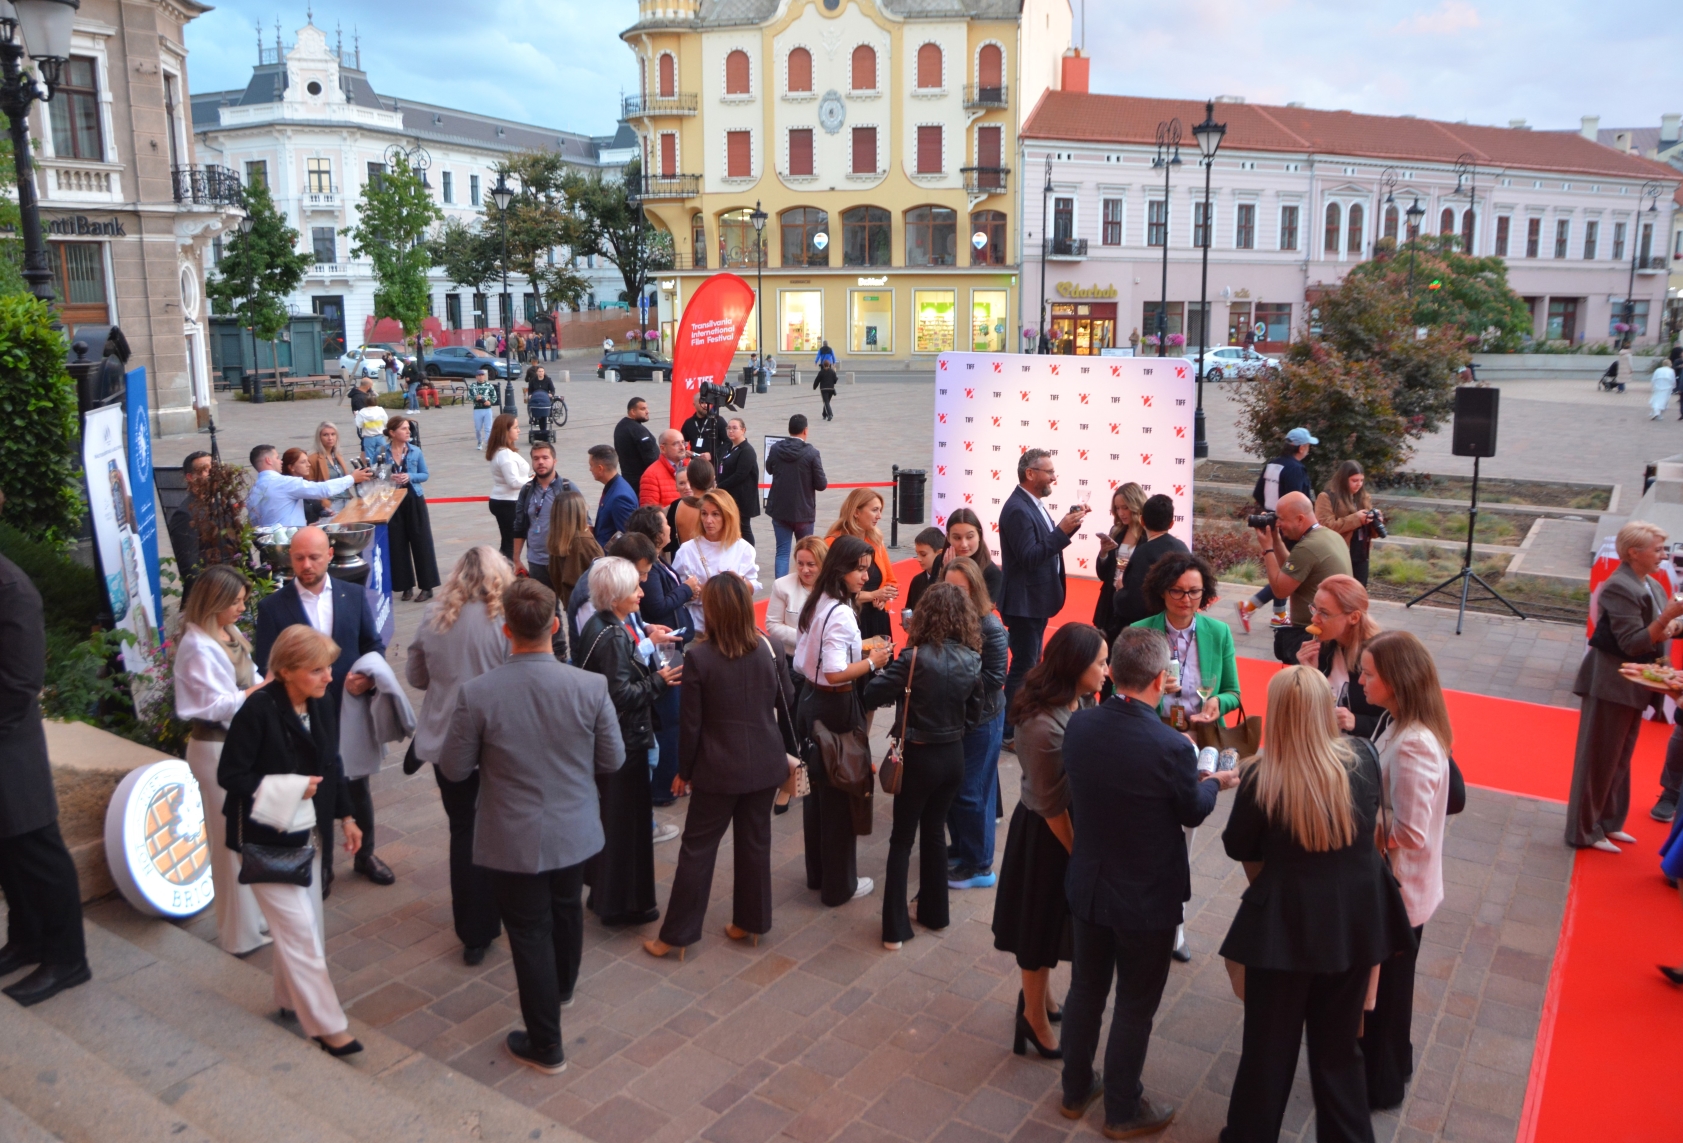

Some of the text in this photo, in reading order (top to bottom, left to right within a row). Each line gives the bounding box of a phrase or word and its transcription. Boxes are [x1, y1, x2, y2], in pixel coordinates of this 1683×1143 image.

[691, 318, 732, 330] Transilvania
[692, 325, 734, 338] International
[707, 334, 734, 344] Festival
[172, 874, 213, 908] BRIC
